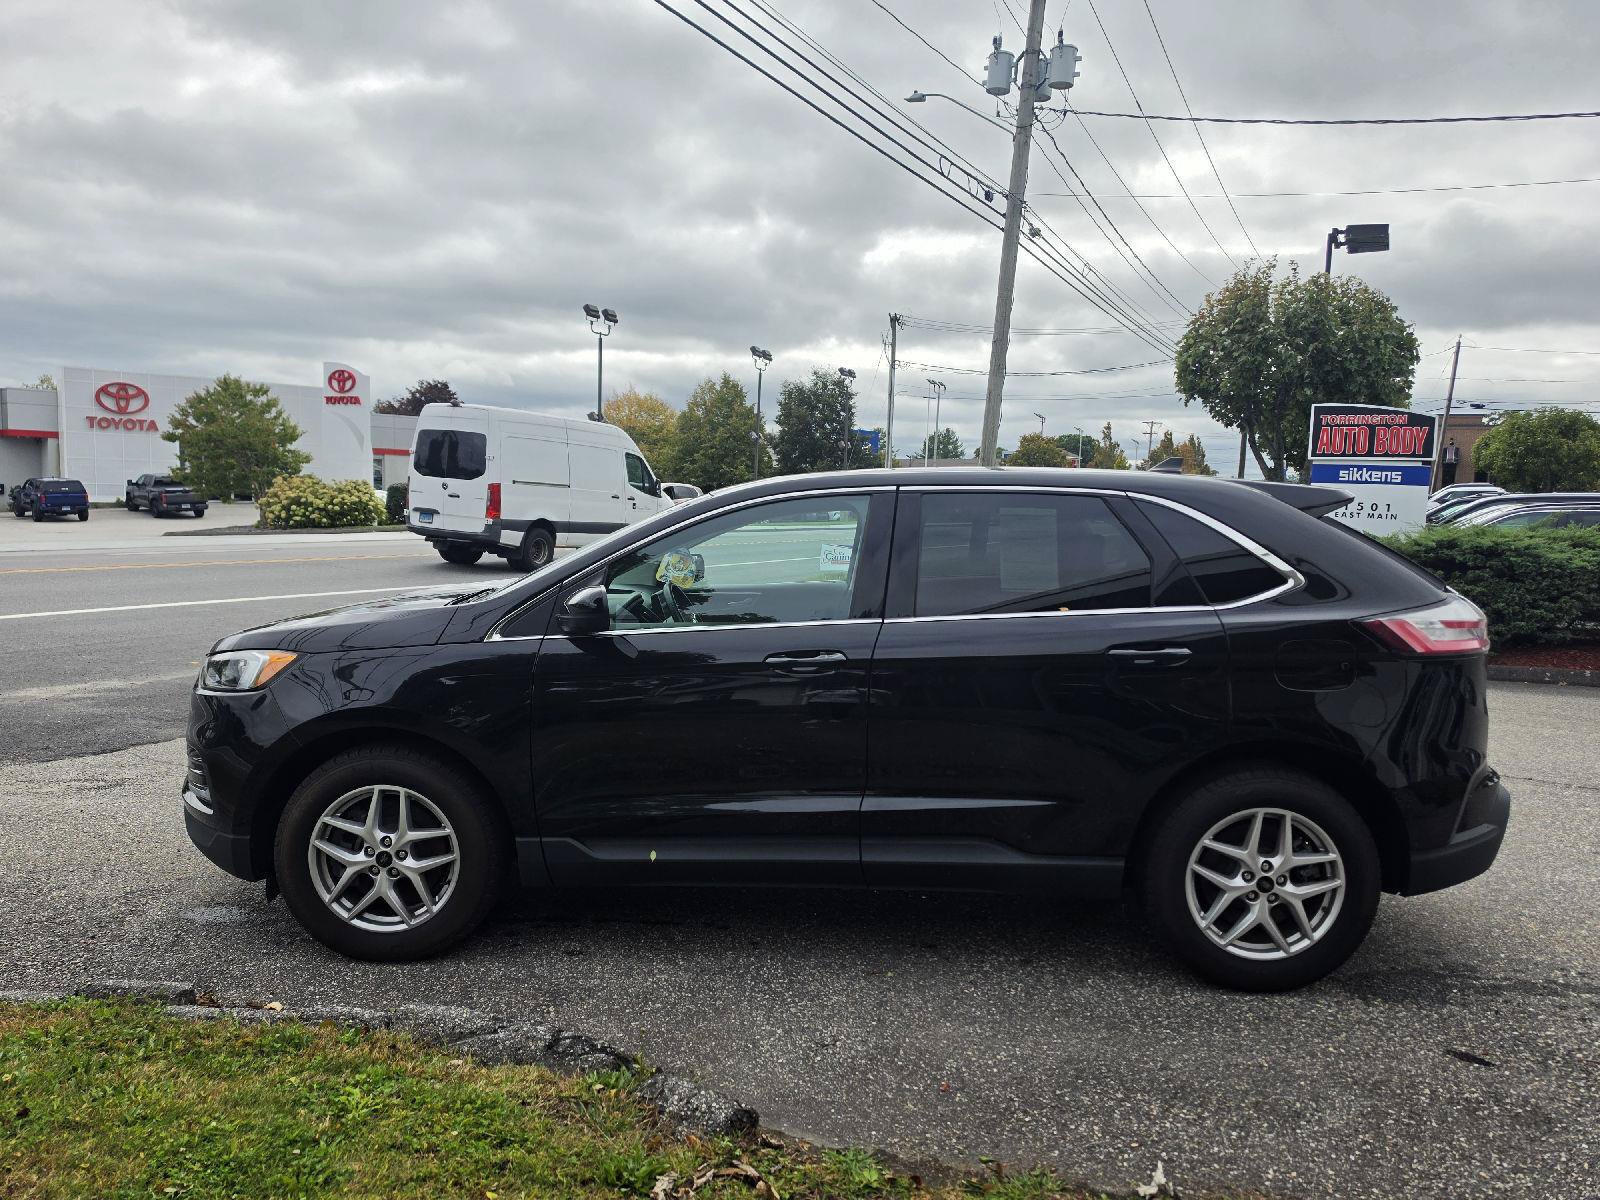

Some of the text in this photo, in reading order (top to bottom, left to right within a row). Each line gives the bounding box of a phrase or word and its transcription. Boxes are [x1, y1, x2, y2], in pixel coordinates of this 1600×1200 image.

[324, 395, 362, 406] TOYOTA
[86, 415, 159, 433] TOYOTA
[1320, 414, 1408, 425] TORRINGTON
[1317, 426, 1429, 455] AUTO BODY
[1338, 468, 1402, 483] sikkens
[1334, 511, 1398, 520] EAST MAIN
